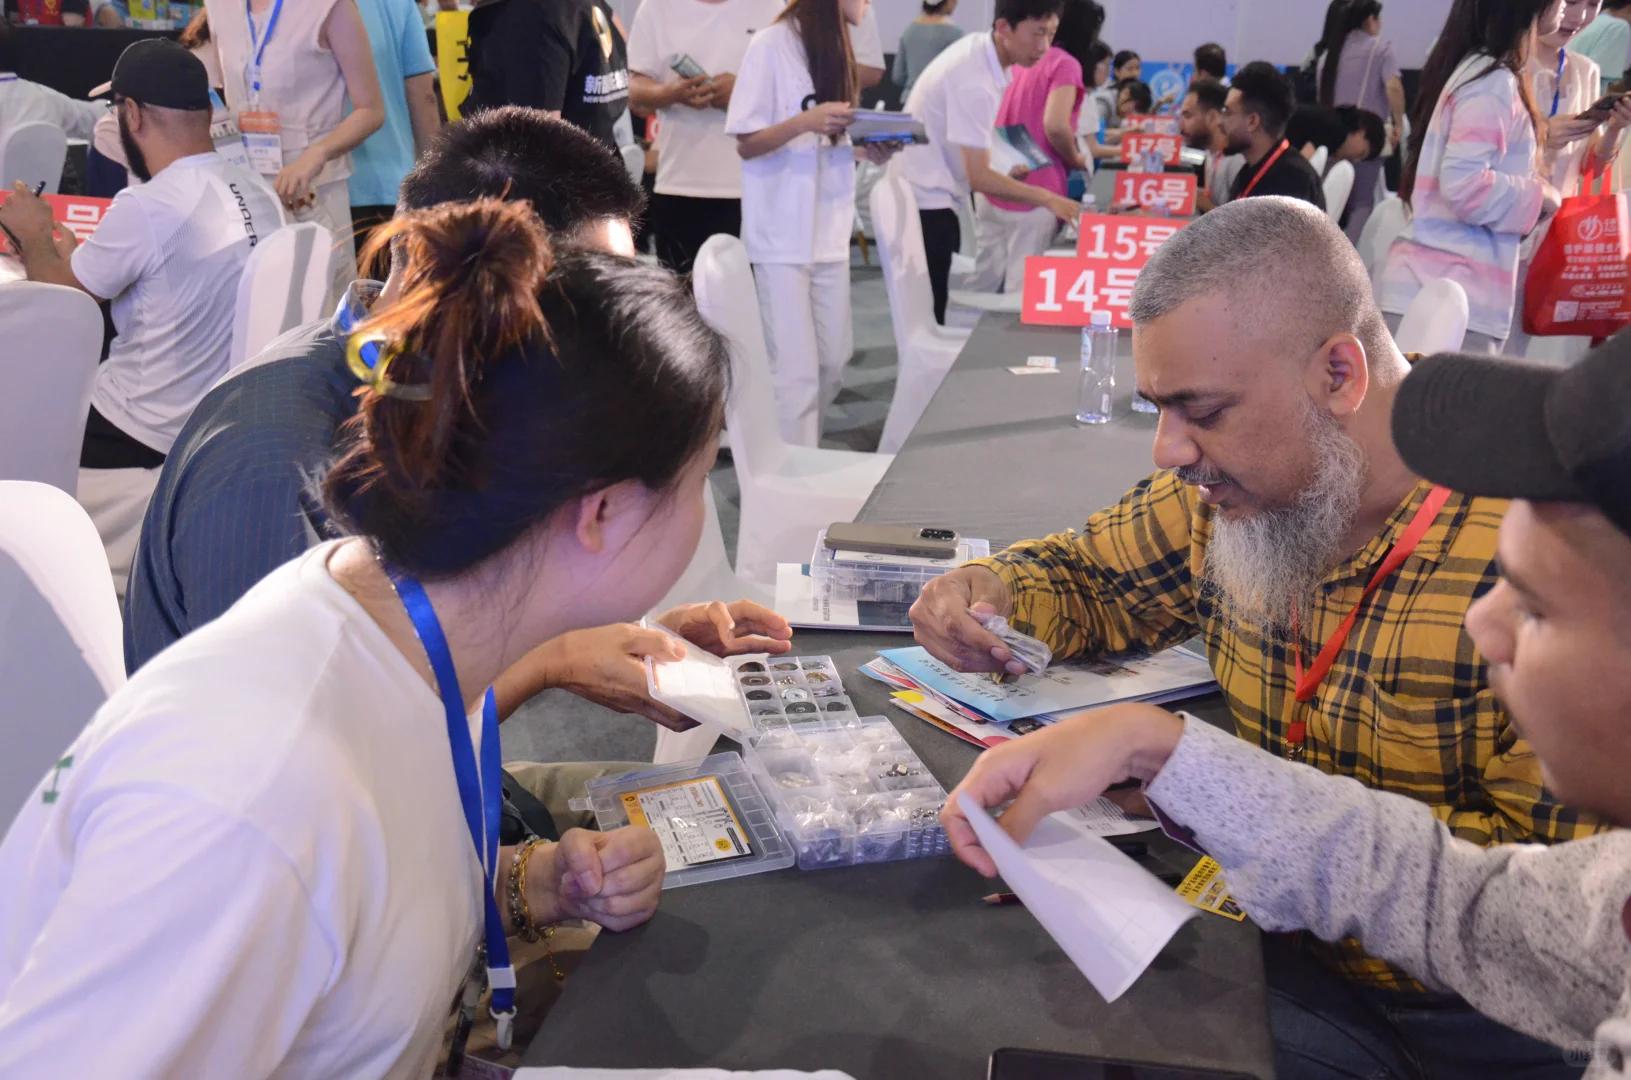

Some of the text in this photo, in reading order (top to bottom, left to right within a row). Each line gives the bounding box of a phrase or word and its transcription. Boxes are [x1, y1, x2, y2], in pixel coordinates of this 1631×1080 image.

[229, 183, 258, 247] UNDER
[1119, 178, 1190, 211] 16号
[1087, 223, 1178, 261] 15号
[1035, 267, 1142, 320] 14号
